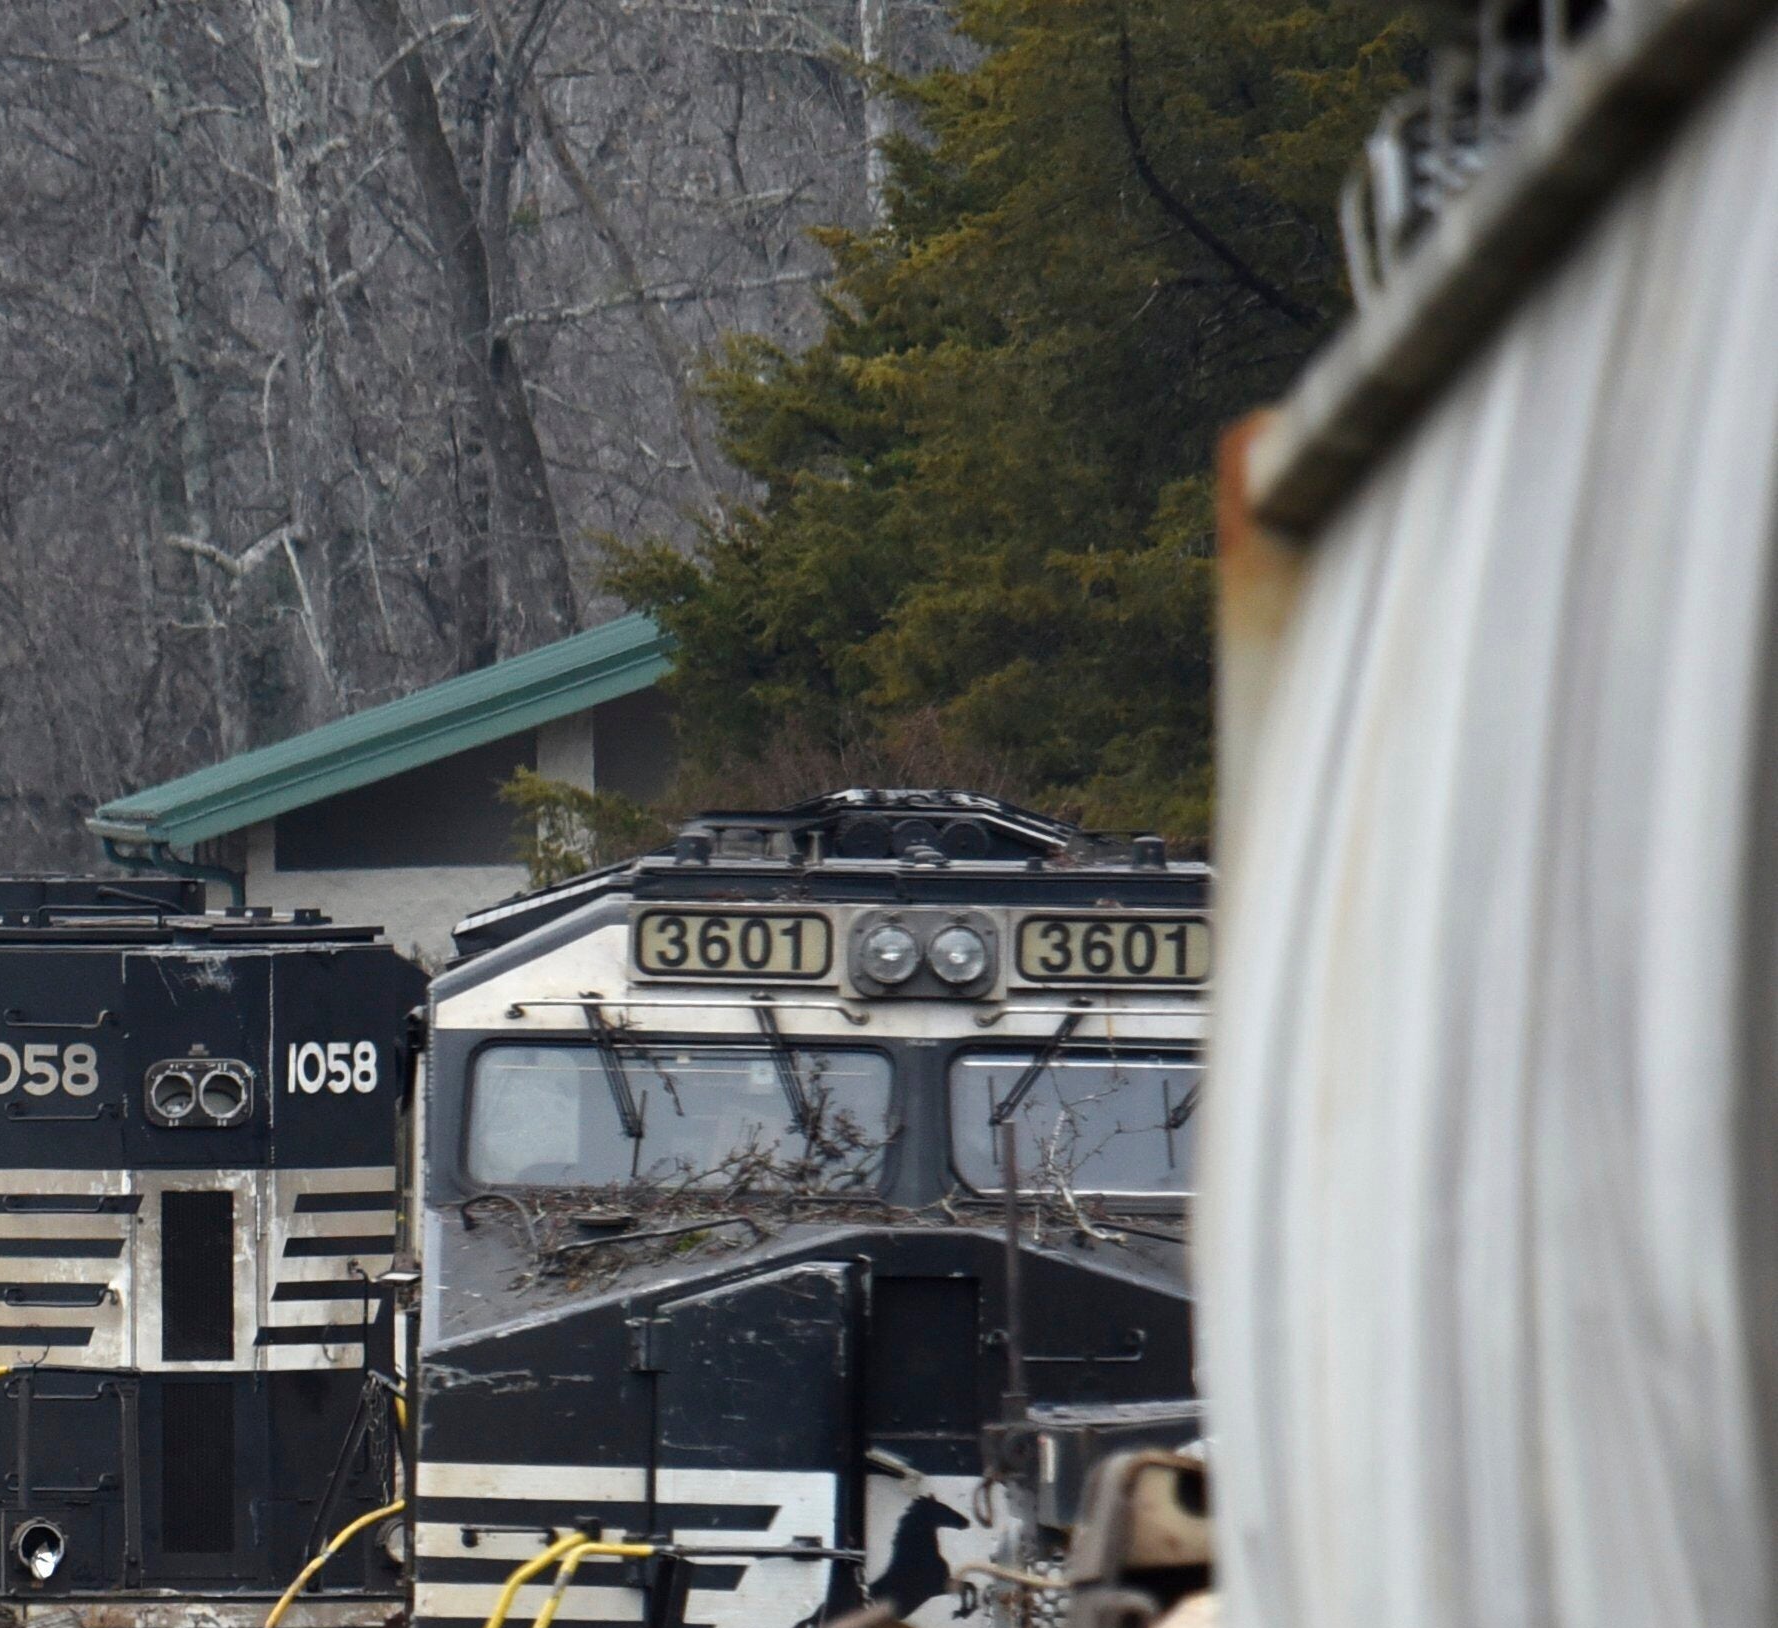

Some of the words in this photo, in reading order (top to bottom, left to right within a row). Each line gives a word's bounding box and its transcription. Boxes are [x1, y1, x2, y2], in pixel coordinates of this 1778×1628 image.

[656, 916, 804, 971] 3601
[1039, 922, 1187, 975] 3601
[287, 1041, 379, 1095] 1058
